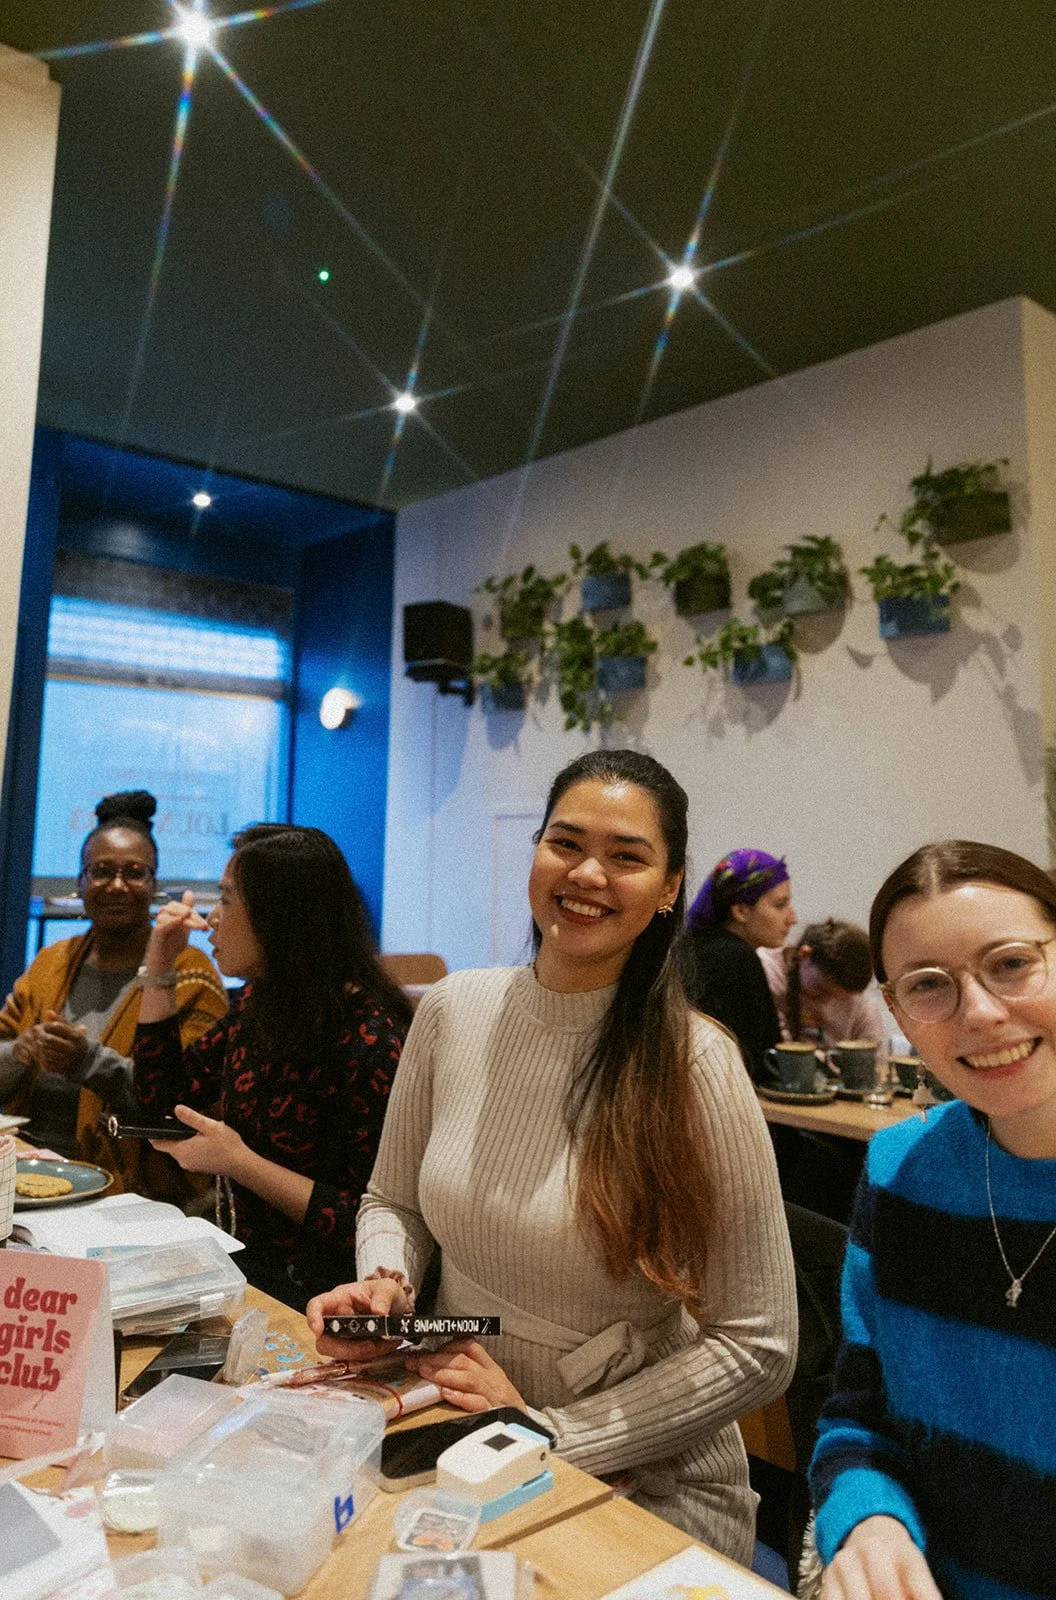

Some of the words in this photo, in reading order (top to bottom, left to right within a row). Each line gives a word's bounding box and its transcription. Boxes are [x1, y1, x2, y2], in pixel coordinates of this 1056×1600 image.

[4, 1277, 78, 1315] dear
[0, 1315, 71, 1356] girls
[0, 1353, 60, 1392] club
